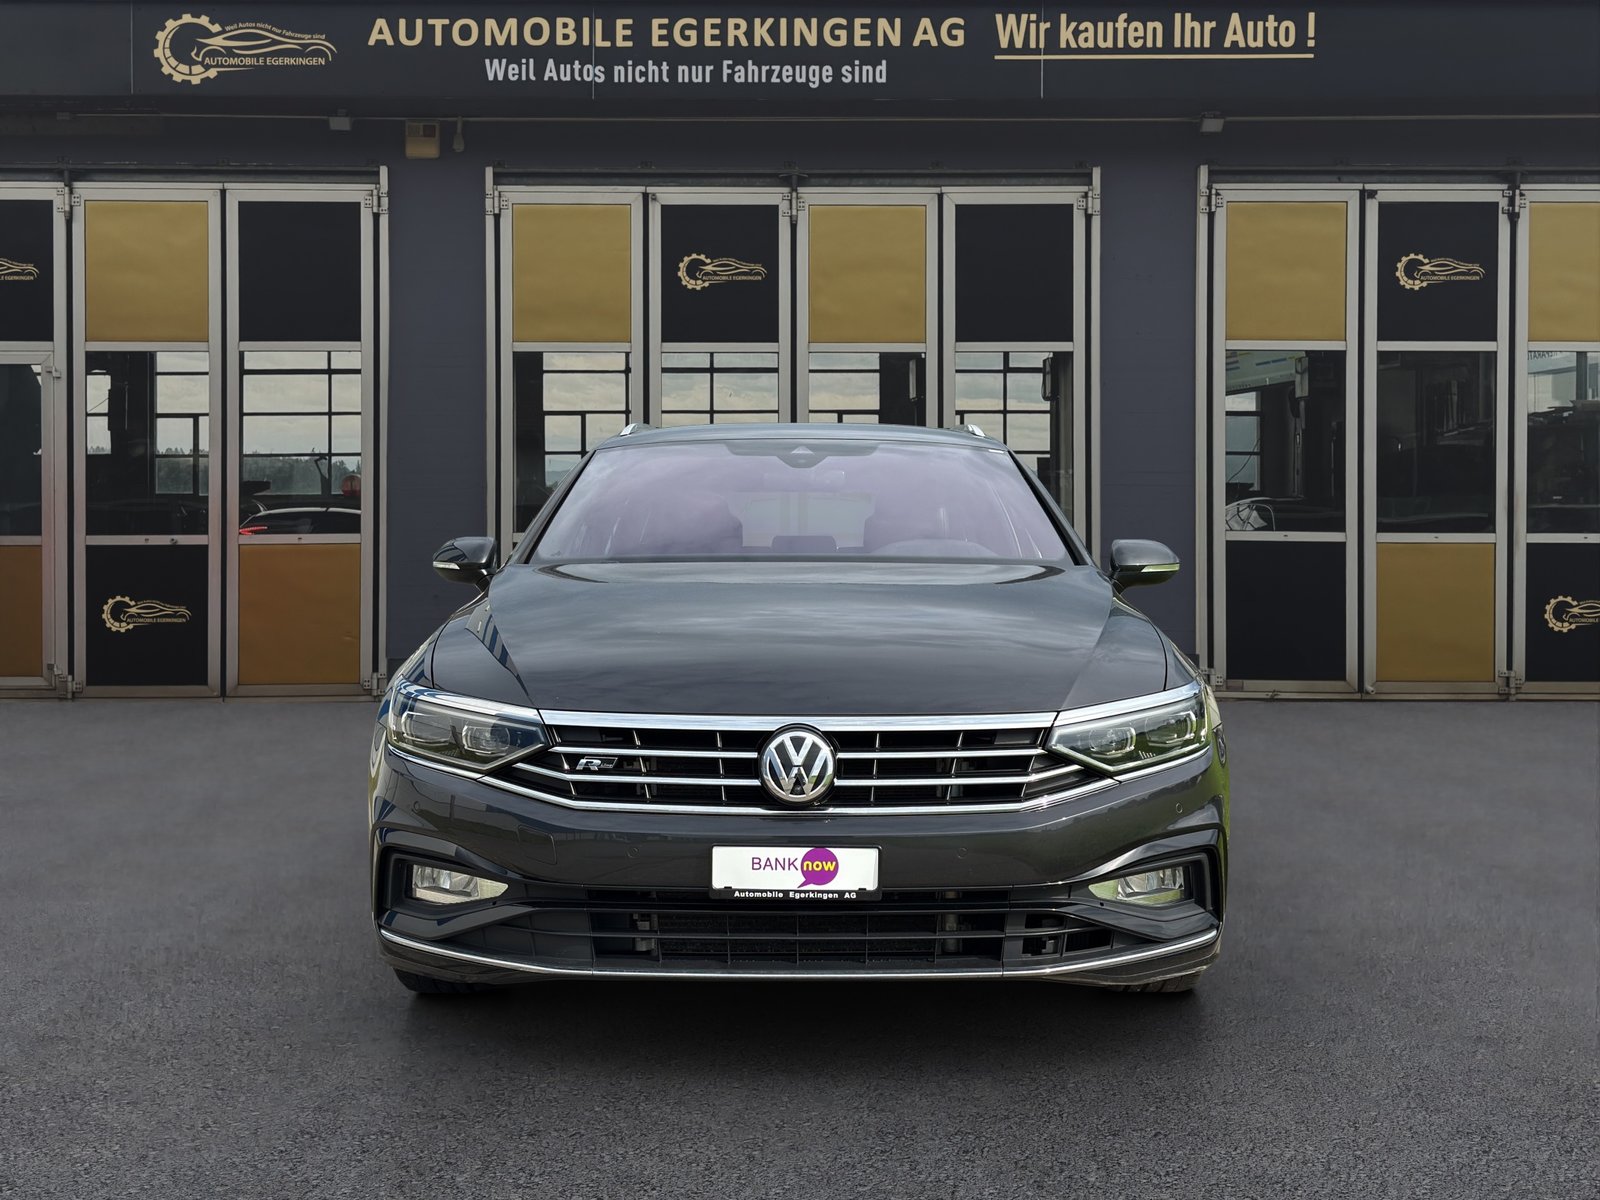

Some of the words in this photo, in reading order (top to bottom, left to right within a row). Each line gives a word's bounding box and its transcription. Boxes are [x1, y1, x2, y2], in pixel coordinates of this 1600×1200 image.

[225, 23, 238, 32] Weil
[256, 22, 272, 31] nicht
[272, 26, 282, 34] nur
[282, 29, 312, 40] Fahrzeuge
[367, 16, 634, 48] AUTOMOBILE
[650, 17, 902, 47] EGERKINGEN
[912, 17, 966, 47] AG
[995, 13, 1050, 49] Wir
[1059, 12, 1163, 48] kaufen
[1174, 12, 1216, 48] Ihr
[1223, 12, 1296, 48] Auto
[1306, 11, 1316, 48] !
[204, 57, 265, 66] AUTOMOBILE
[266, 57, 326, 66] EGERKINGEN
[484, 58, 536, 81] Weil
[543, 58, 606, 83] Autos
[613, 60, 669, 83] nicht
[677, 64, 714, 83] nur
[722, 60, 834, 88] Fahrzeuge
[841, 60, 888, 83] sind
[751, 857, 799, 871] BANK
[803, 860, 836, 871] now
[733, 890, 784, 898] Automobile
[788, 891, 839, 899] Egerkingen
